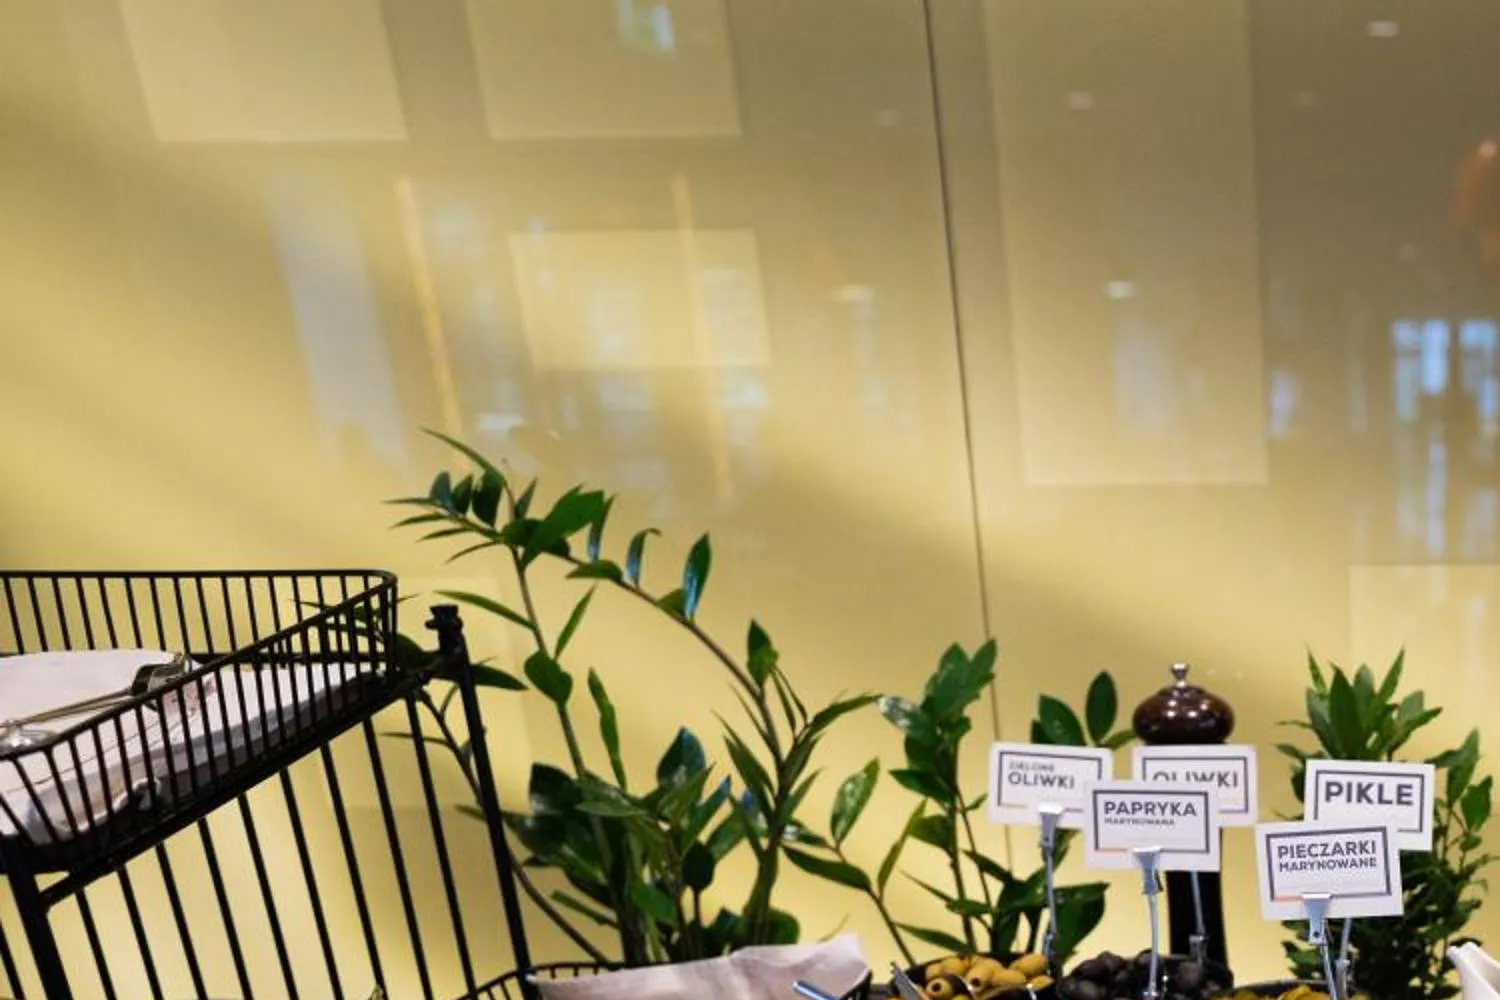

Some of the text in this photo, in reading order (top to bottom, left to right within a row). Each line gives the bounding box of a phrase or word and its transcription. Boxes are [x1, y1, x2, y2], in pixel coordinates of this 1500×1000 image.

[1007, 771, 1075, 790] OLIWKI
[1325, 780, 1414, 806] PIKLE
[1103, 801, 1197, 817] PAPRYKA
[1277, 839, 1377, 859] PIECZARKI
[1279, 857, 1377, 873] MARYNOWANE
